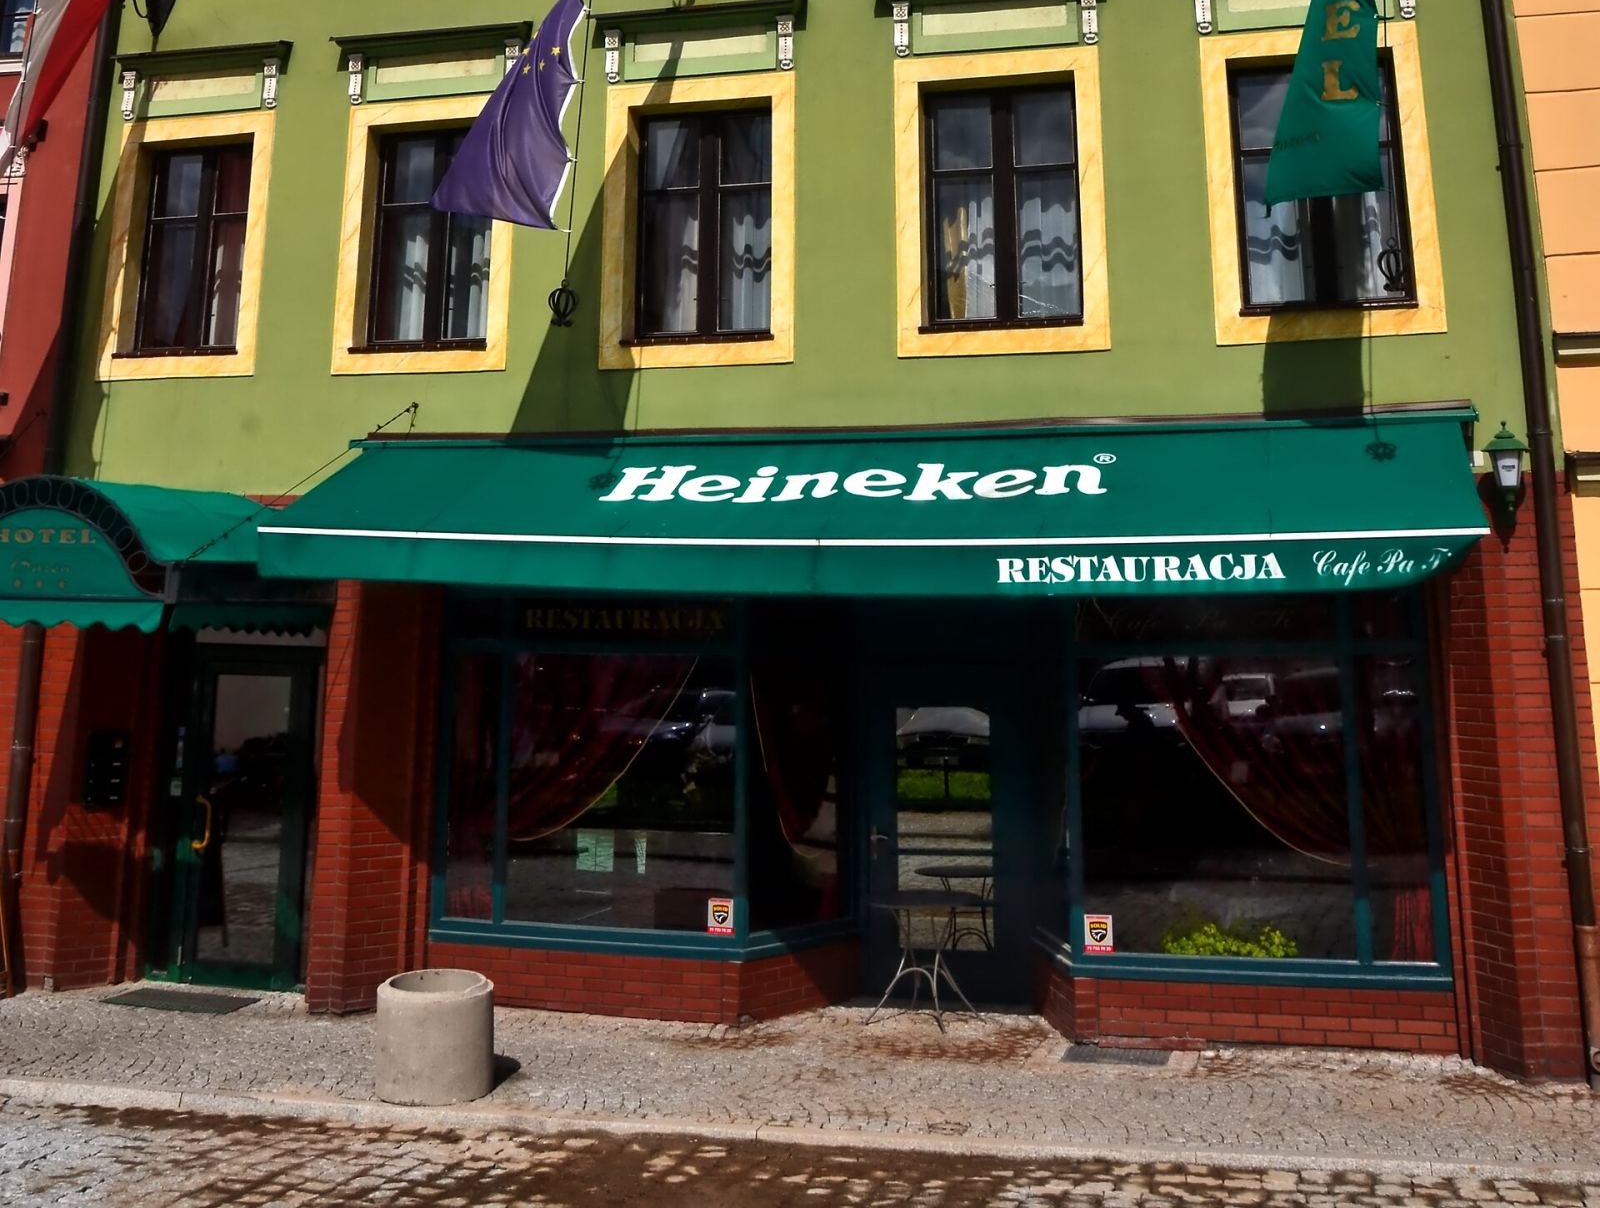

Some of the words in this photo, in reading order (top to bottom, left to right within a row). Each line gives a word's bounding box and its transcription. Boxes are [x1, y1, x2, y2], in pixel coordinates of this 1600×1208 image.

[599, 464, 1107, 503] Heineken
[997, 553, 1285, 583] RESTAURACJA
[1313, 551, 1370, 585] Cafe
